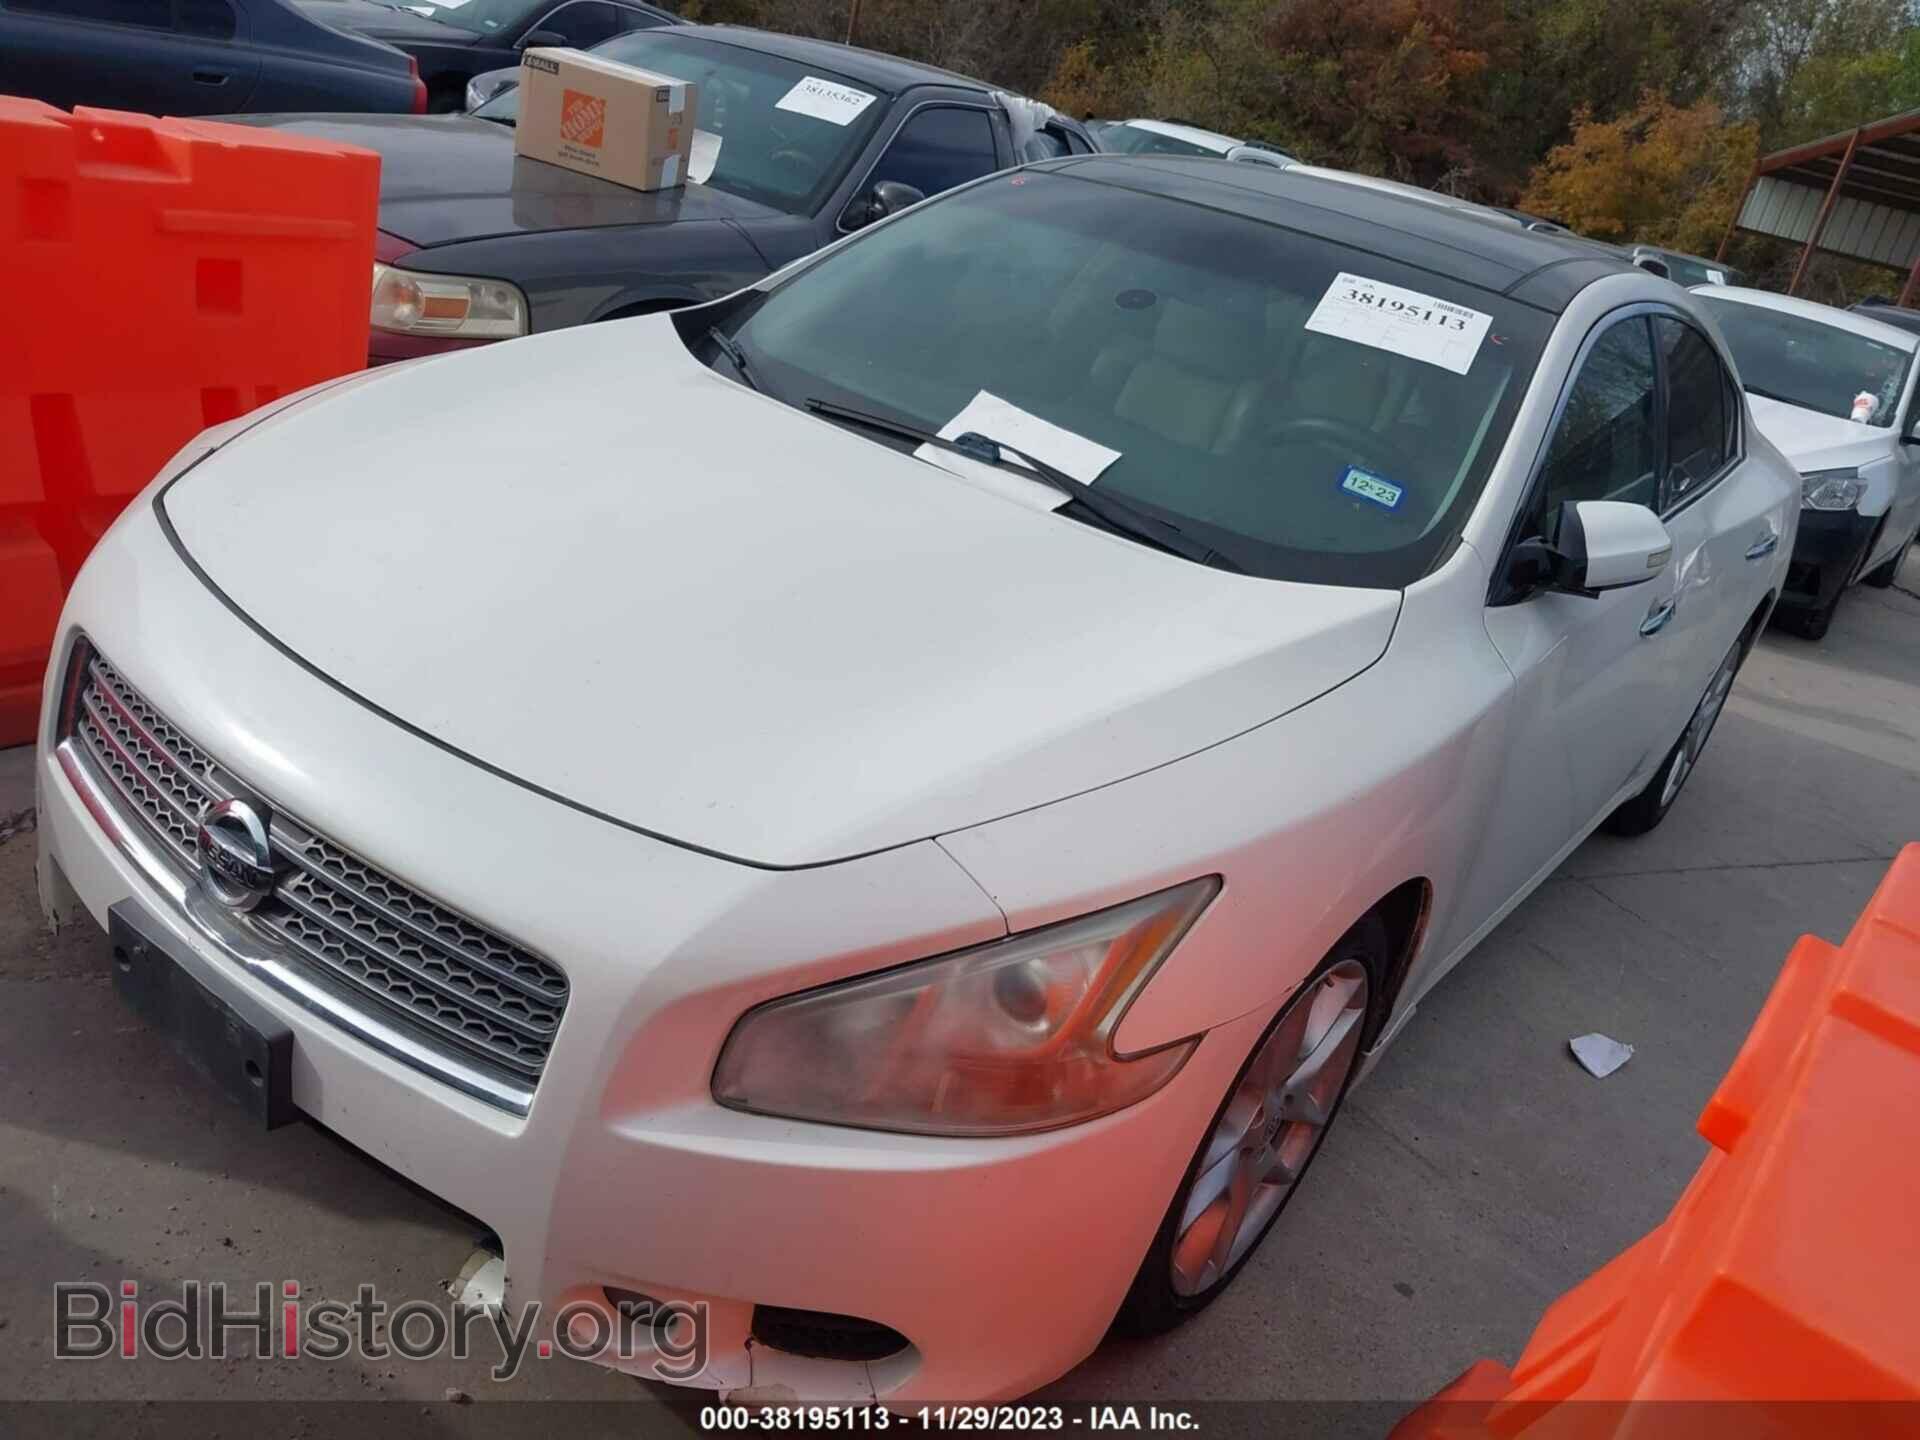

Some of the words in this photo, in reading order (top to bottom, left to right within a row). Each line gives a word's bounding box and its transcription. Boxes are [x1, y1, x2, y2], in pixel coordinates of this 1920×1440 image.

[1342, 289, 1466, 331] 38195113
[1351, 477, 1369, 491] 12
[1375, 487, 1397, 502] 23
